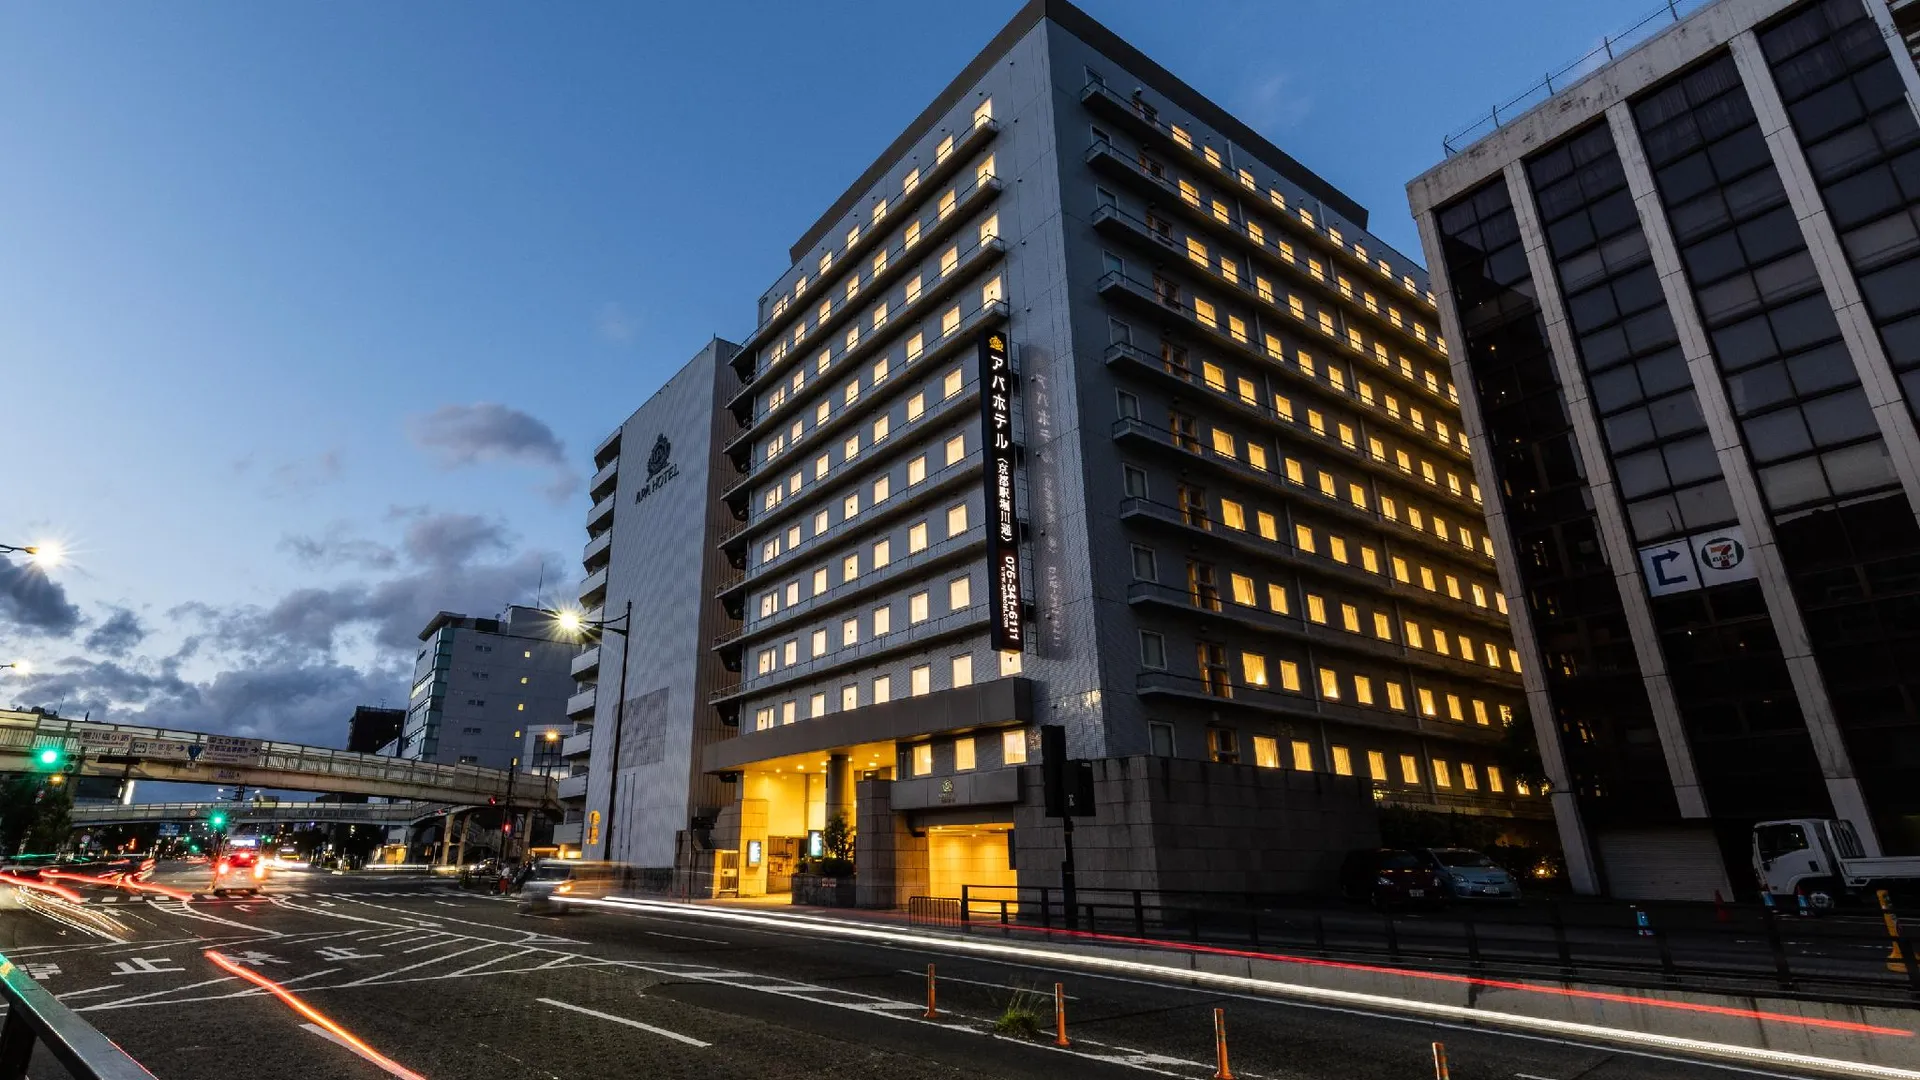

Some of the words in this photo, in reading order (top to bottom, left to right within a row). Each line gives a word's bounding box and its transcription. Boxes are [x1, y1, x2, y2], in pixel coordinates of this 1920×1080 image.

[990, 355, 1009, 449] アパホテル
[635, 484, 651, 505] APA
[652, 464, 680, 492] HOTEL
[1005, 556, 1019, 641] 075-341-6111
